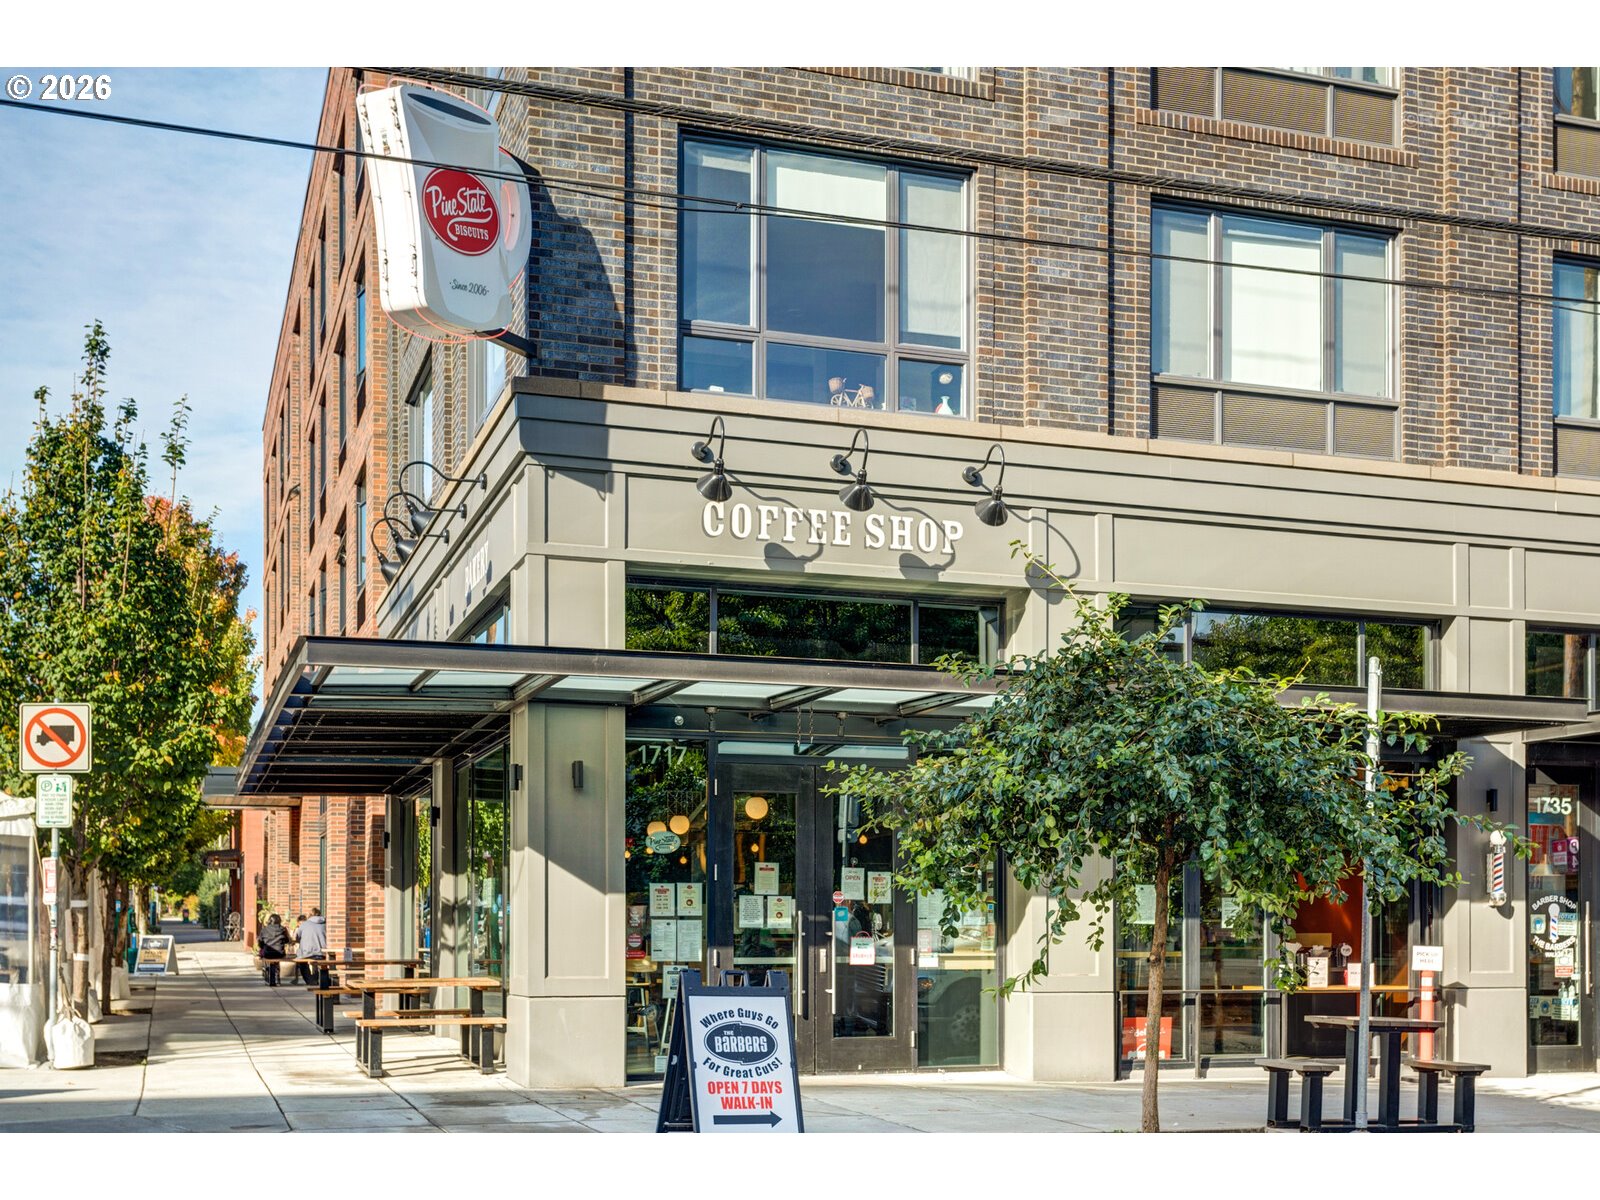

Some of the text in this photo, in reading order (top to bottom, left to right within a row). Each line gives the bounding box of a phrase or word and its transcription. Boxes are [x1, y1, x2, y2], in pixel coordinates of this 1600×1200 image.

[426, 186, 492, 218] Pine State
[454, 223, 490, 241] BISCUITS
[702, 500, 964, 554] COFFEE SHOP
[638, 745, 688, 766] 1717
[1533, 797, 1572, 815] 1735
[1531, 895, 1577, 911] BARBER SHOP
[1532, 935, 1577, 951] THE BARBERS
[700, 1008, 779, 1030] Where Guys Go
[702, 1057, 783, 1079] For Great Cuts!
[707, 1081, 783, 1094] OPEN 7 DAYS
[720, 1096, 773, 1110] WALK-IN
